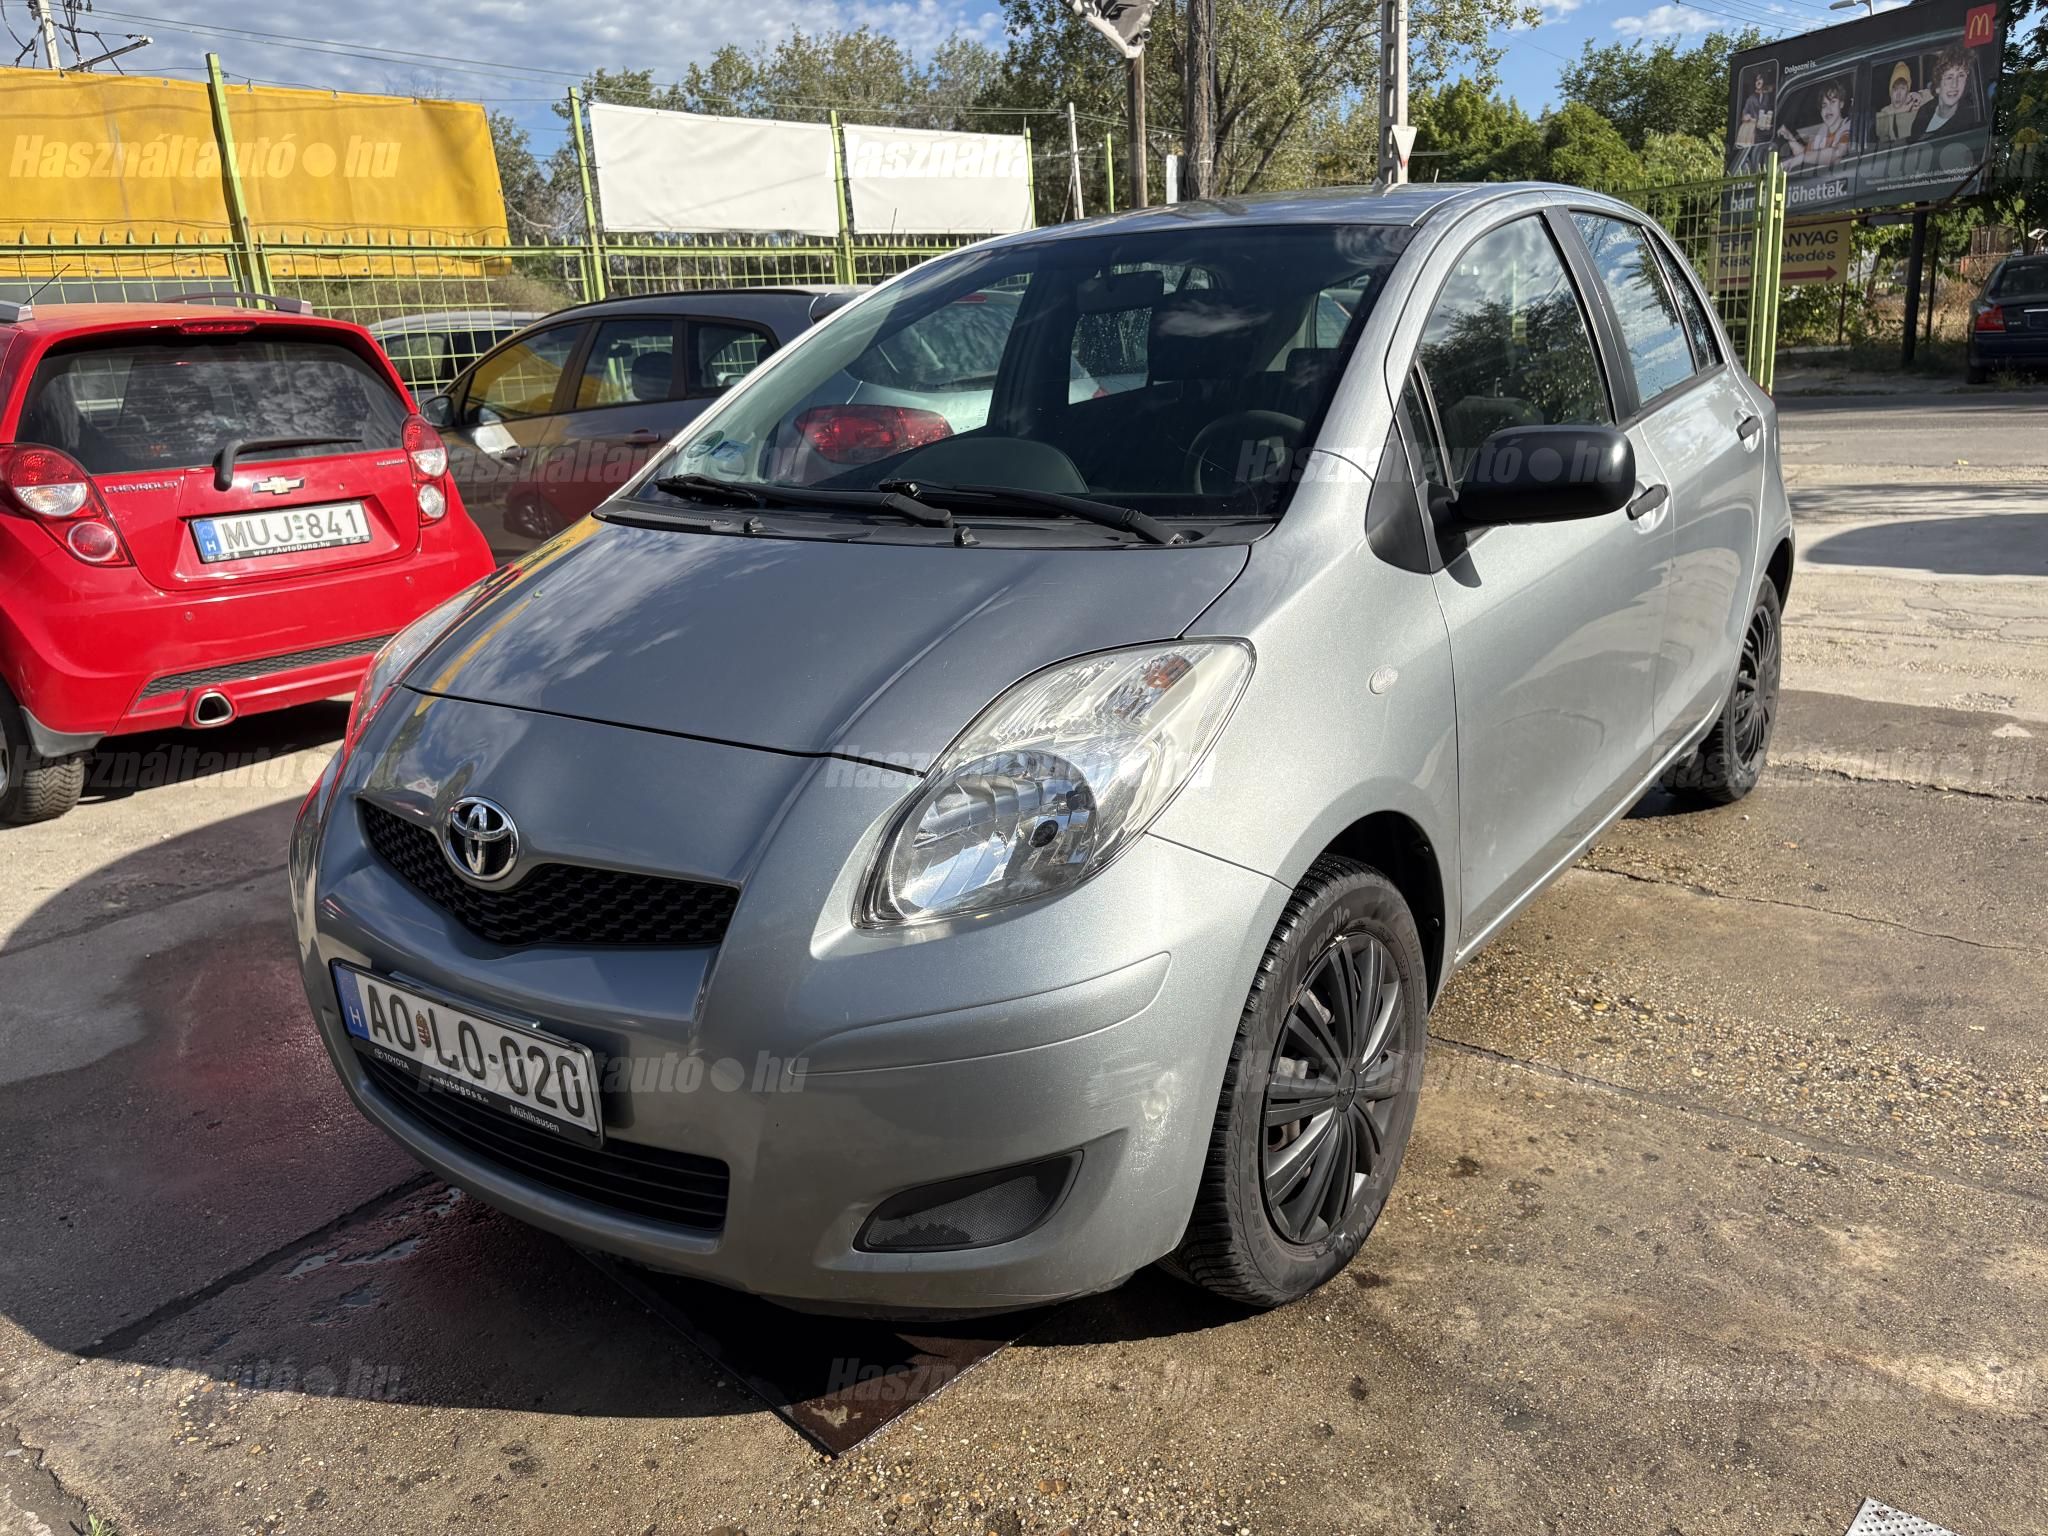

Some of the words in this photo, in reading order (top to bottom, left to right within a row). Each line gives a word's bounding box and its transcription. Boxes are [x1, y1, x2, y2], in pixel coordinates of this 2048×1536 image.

[1786, 181, 1848, 208] jöhettek.
[104, 480, 178, 493] CHEVROLET
[206, 540, 217, 552] H
[349, 1006, 362, 1029] H
[384, 1052, 410, 1072] TOYOTA
[510, 1104, 561, 1134] Mühlhausen
